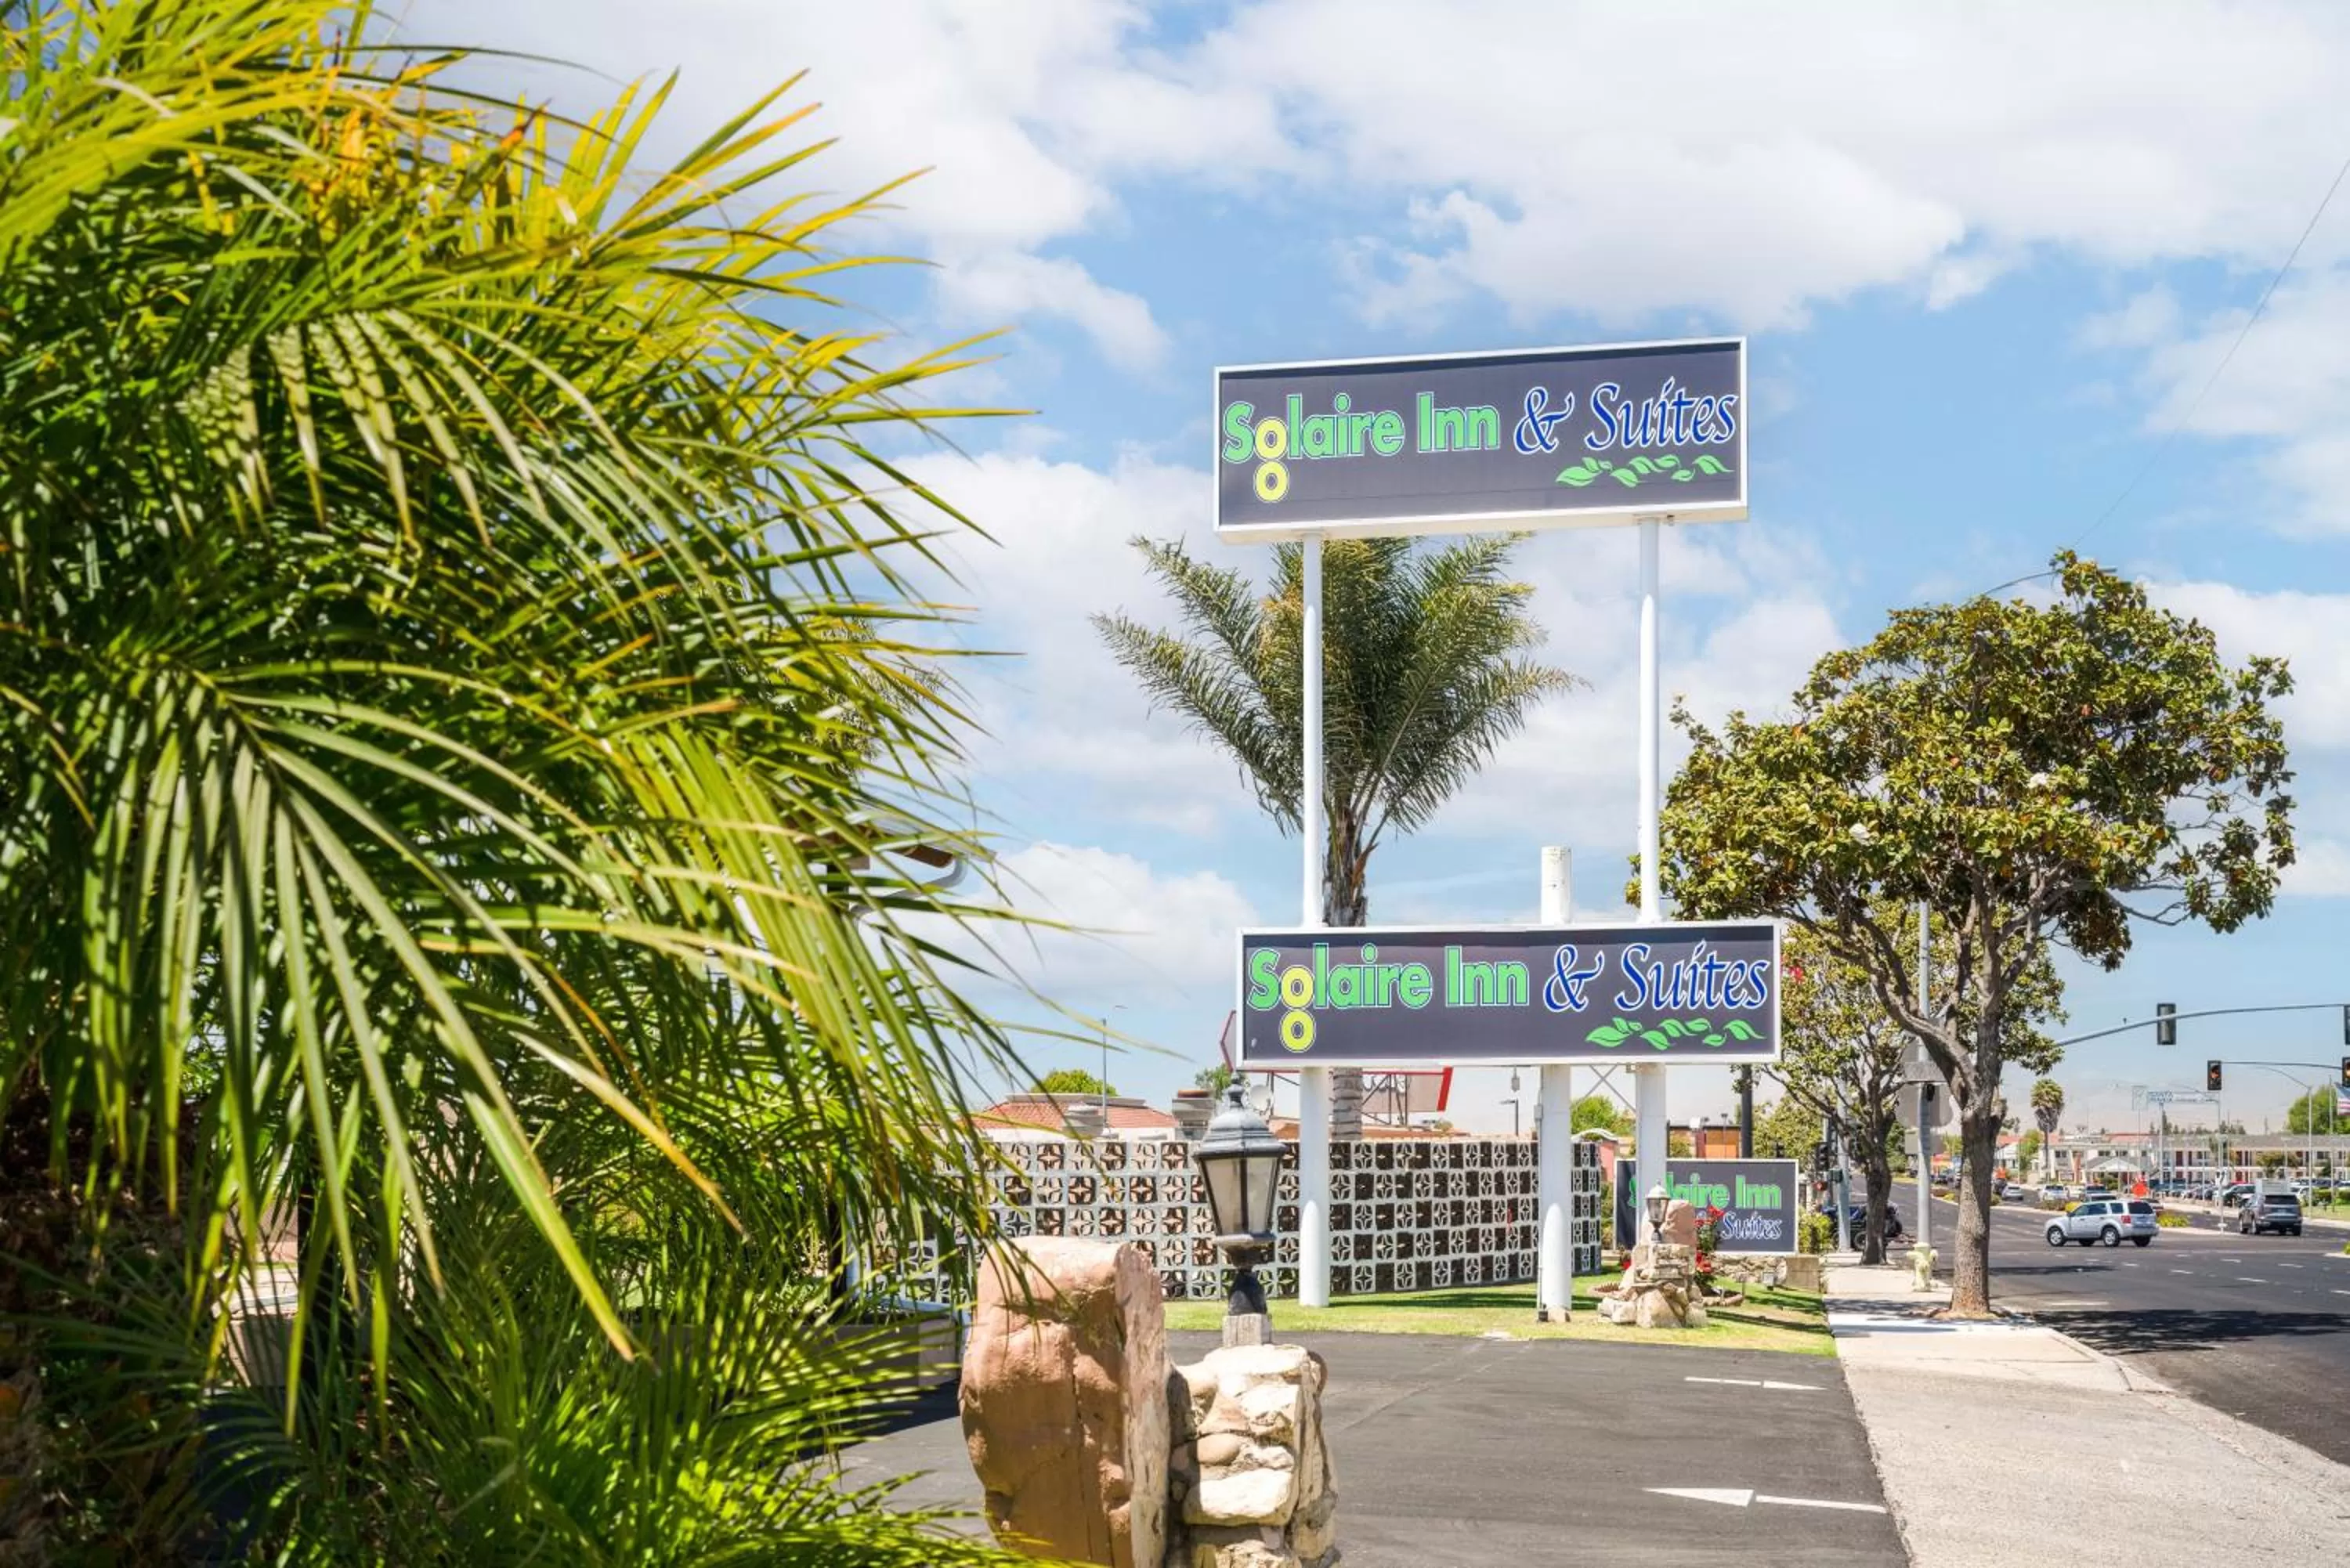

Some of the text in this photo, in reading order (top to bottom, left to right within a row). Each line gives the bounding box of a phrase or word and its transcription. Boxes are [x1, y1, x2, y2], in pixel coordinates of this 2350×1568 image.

[1222, 392, 1405, 464] Solaire
[1416, 392, 1500, 453] Inn
[1513, 386, 1575, 455] &
[1247, 943, 1433, 1010] Solaire
[1444, 945, 1530, 1007] Inn
[1542, 944, 1605, 1012] &
[1735, 1174, 1782, 1209] Inn
